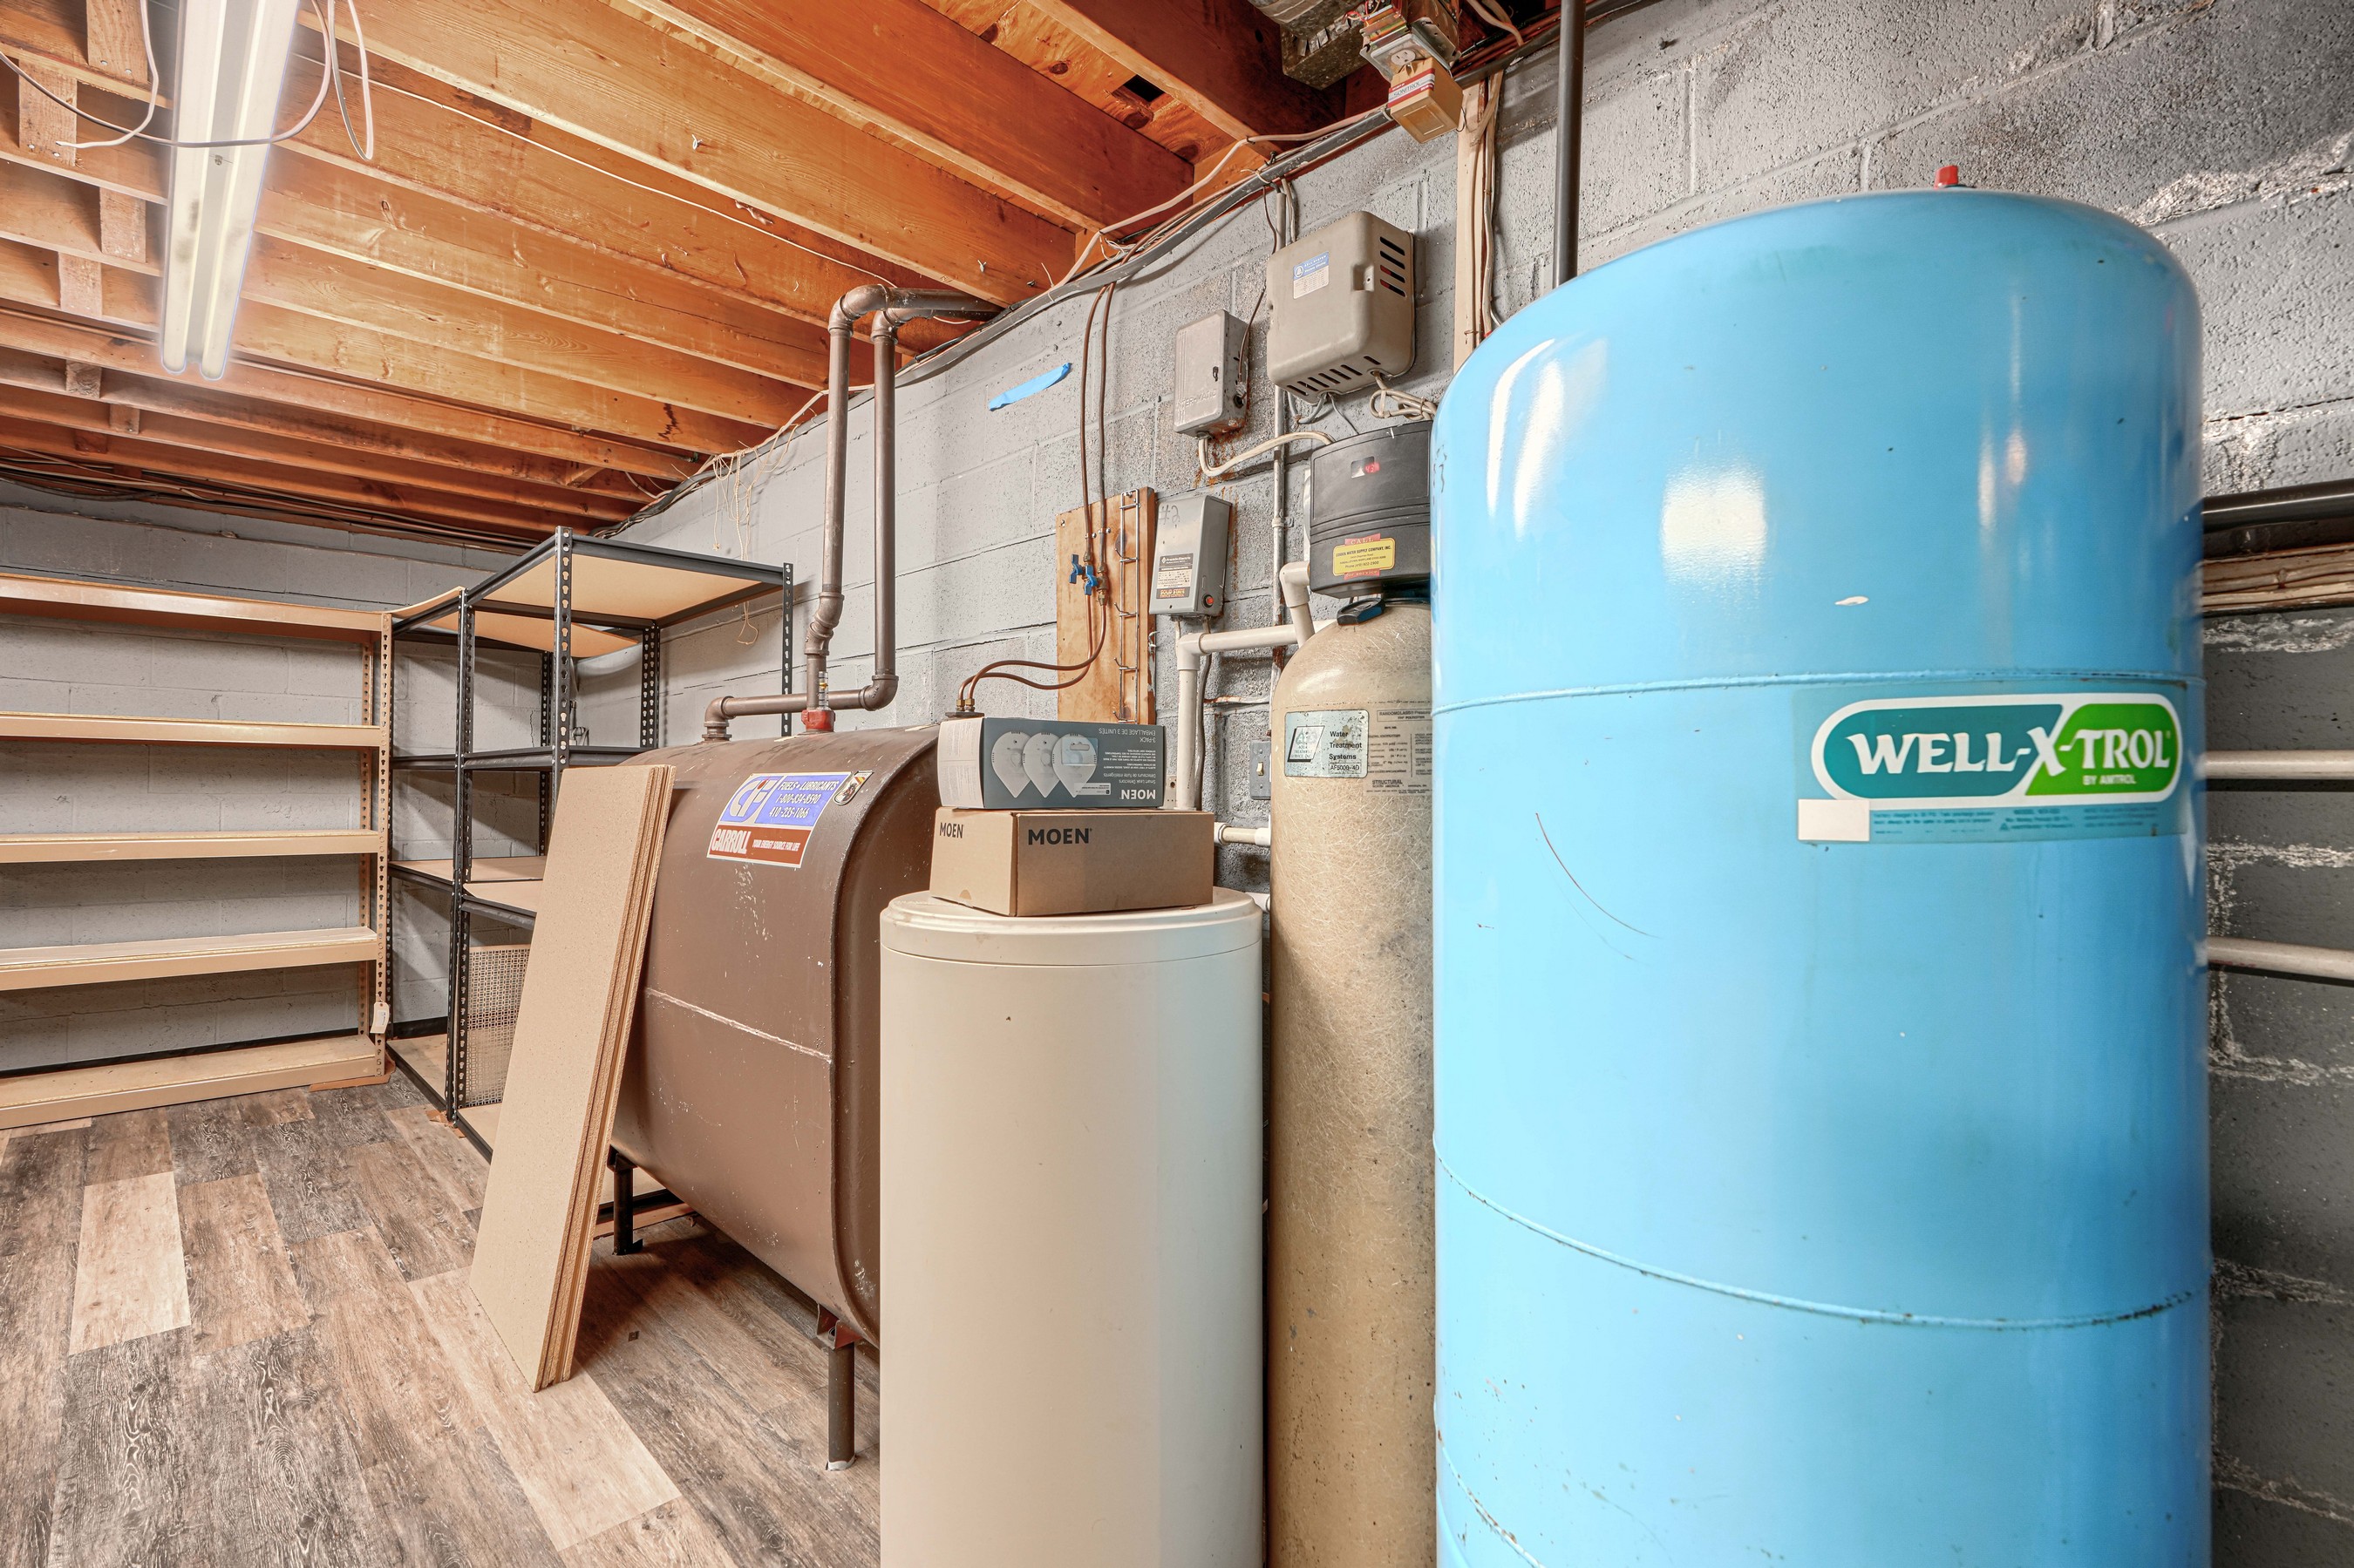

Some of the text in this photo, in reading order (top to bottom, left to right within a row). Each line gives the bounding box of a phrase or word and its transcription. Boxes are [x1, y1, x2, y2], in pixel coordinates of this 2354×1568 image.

[1158, 505, 1180, 525] #2
[1845, 727, 2170, 777] WELL-X-TROL
[777, 780, 840, 791] FUELS LUBRICANTS
[2083, 774, 2137, 785] BY AMTROL
[1121, 789, 1156, 800] MOEN
[939, 822, 963, 838] MOEN
[1028, 828, 1090, 845] MOEN
[711, 828, 752, 855] CARROLL
